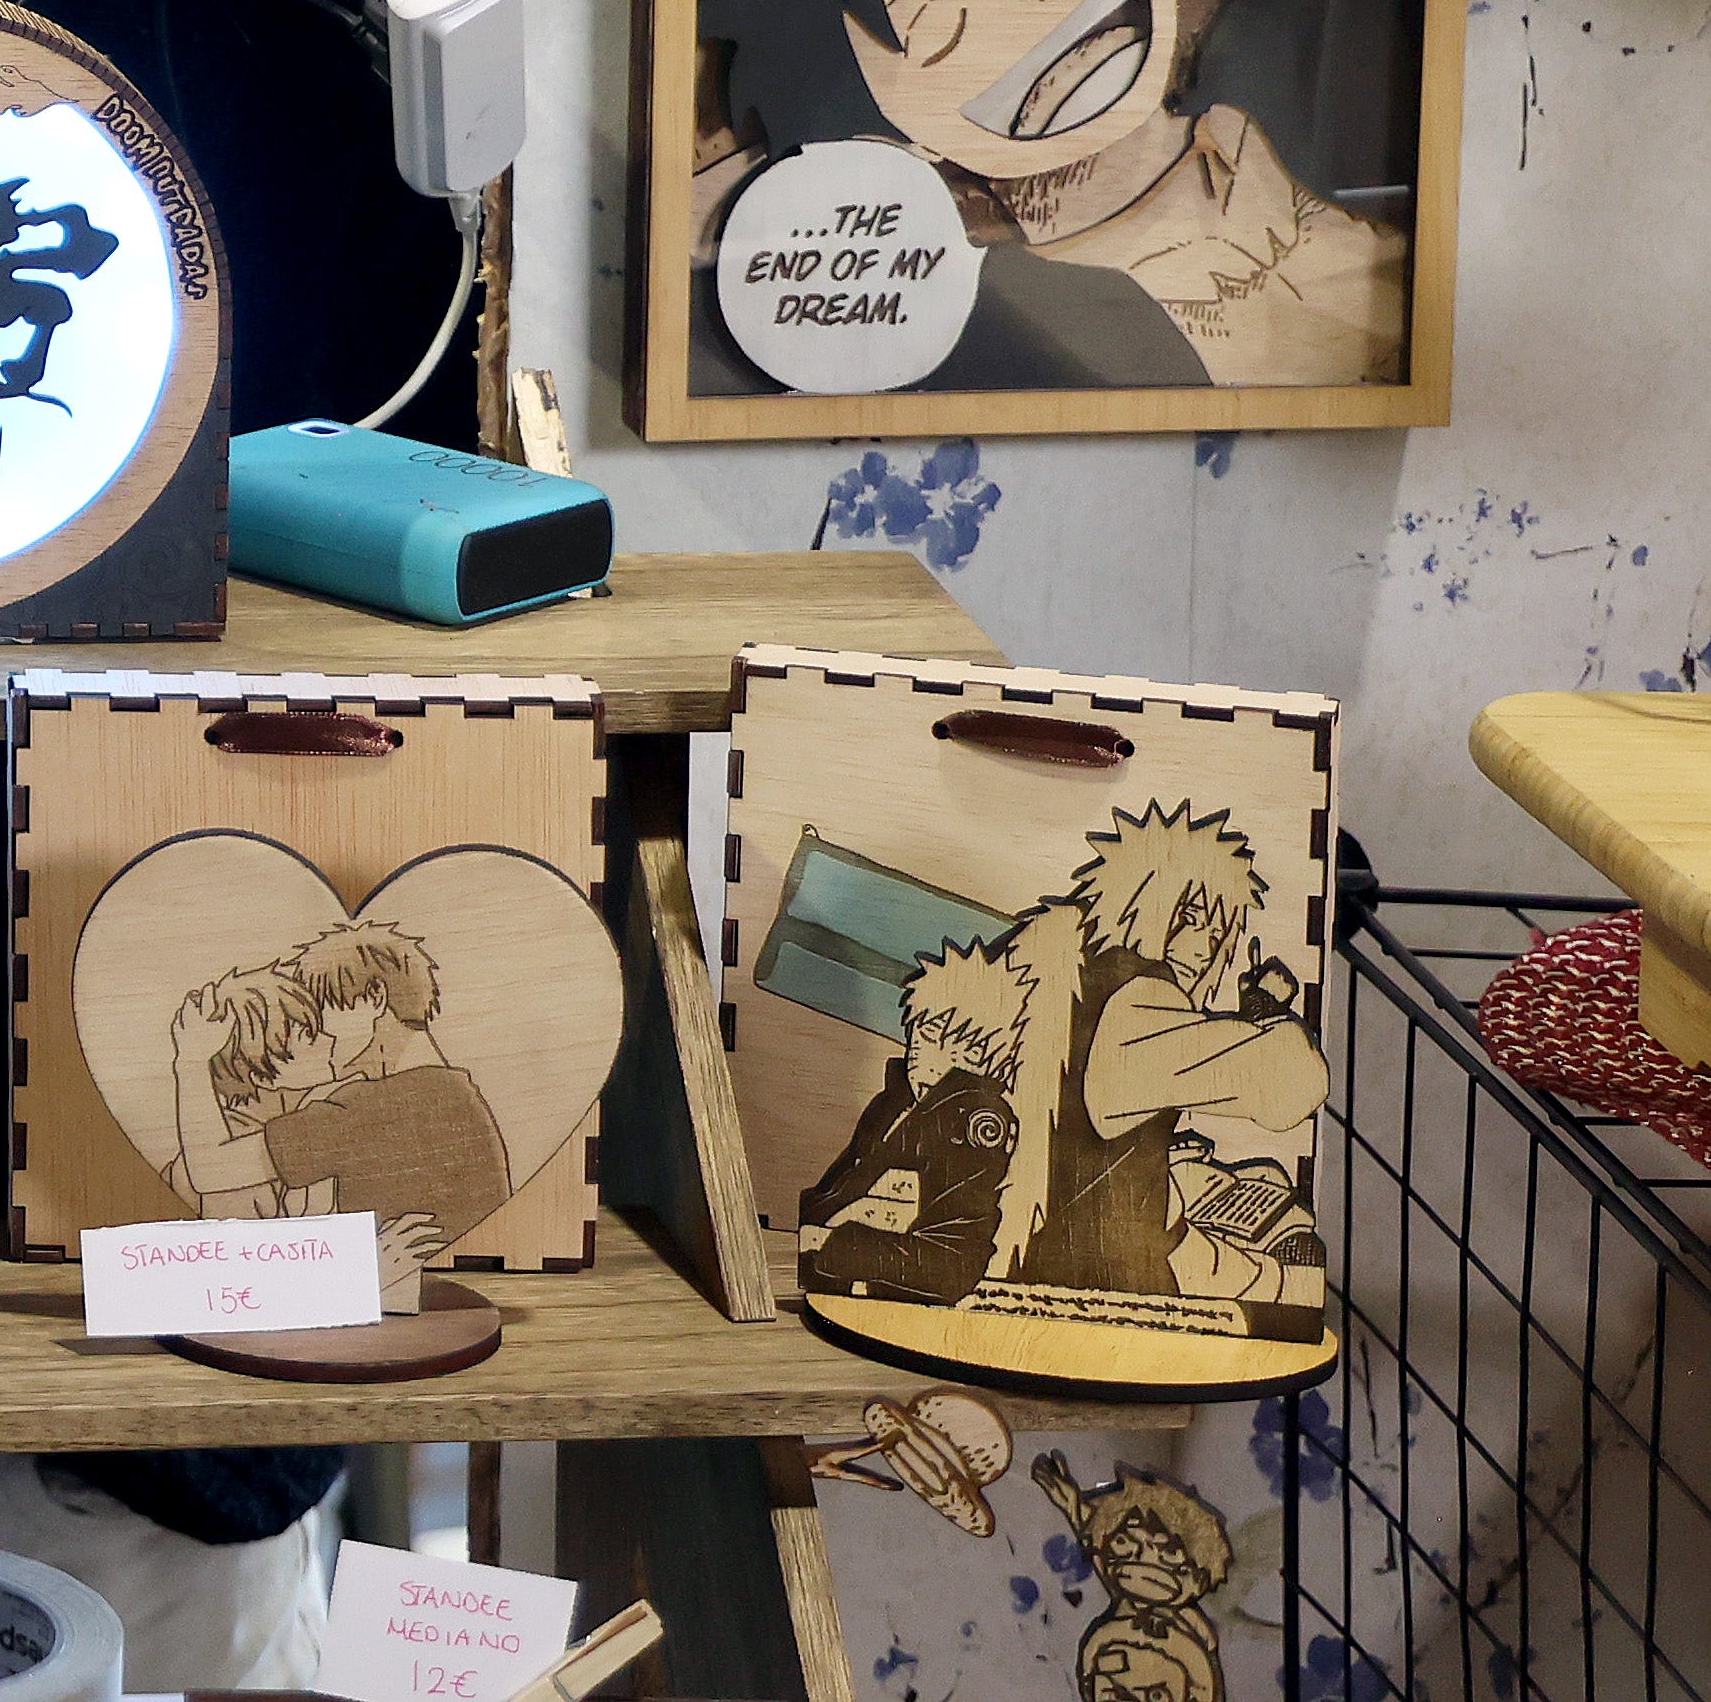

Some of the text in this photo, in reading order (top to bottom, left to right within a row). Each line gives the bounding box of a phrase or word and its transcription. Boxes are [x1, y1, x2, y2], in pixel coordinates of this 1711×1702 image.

[789, 200, 901, 239] ...THE
[744, 246, 948, 284] END OF MY
[774, 291, 911, 329] DREAM.
[408, 450, 548, 488] 10000
[121, 1240, 229, 1270] STANDEE
[206, 1287, 262, 1314] 15€
[400, 1580, 513, 1622] STANDEE
[386, 1617, 521, 1654] MEDIANO
[412, 1659, 479, 1698] 12€
